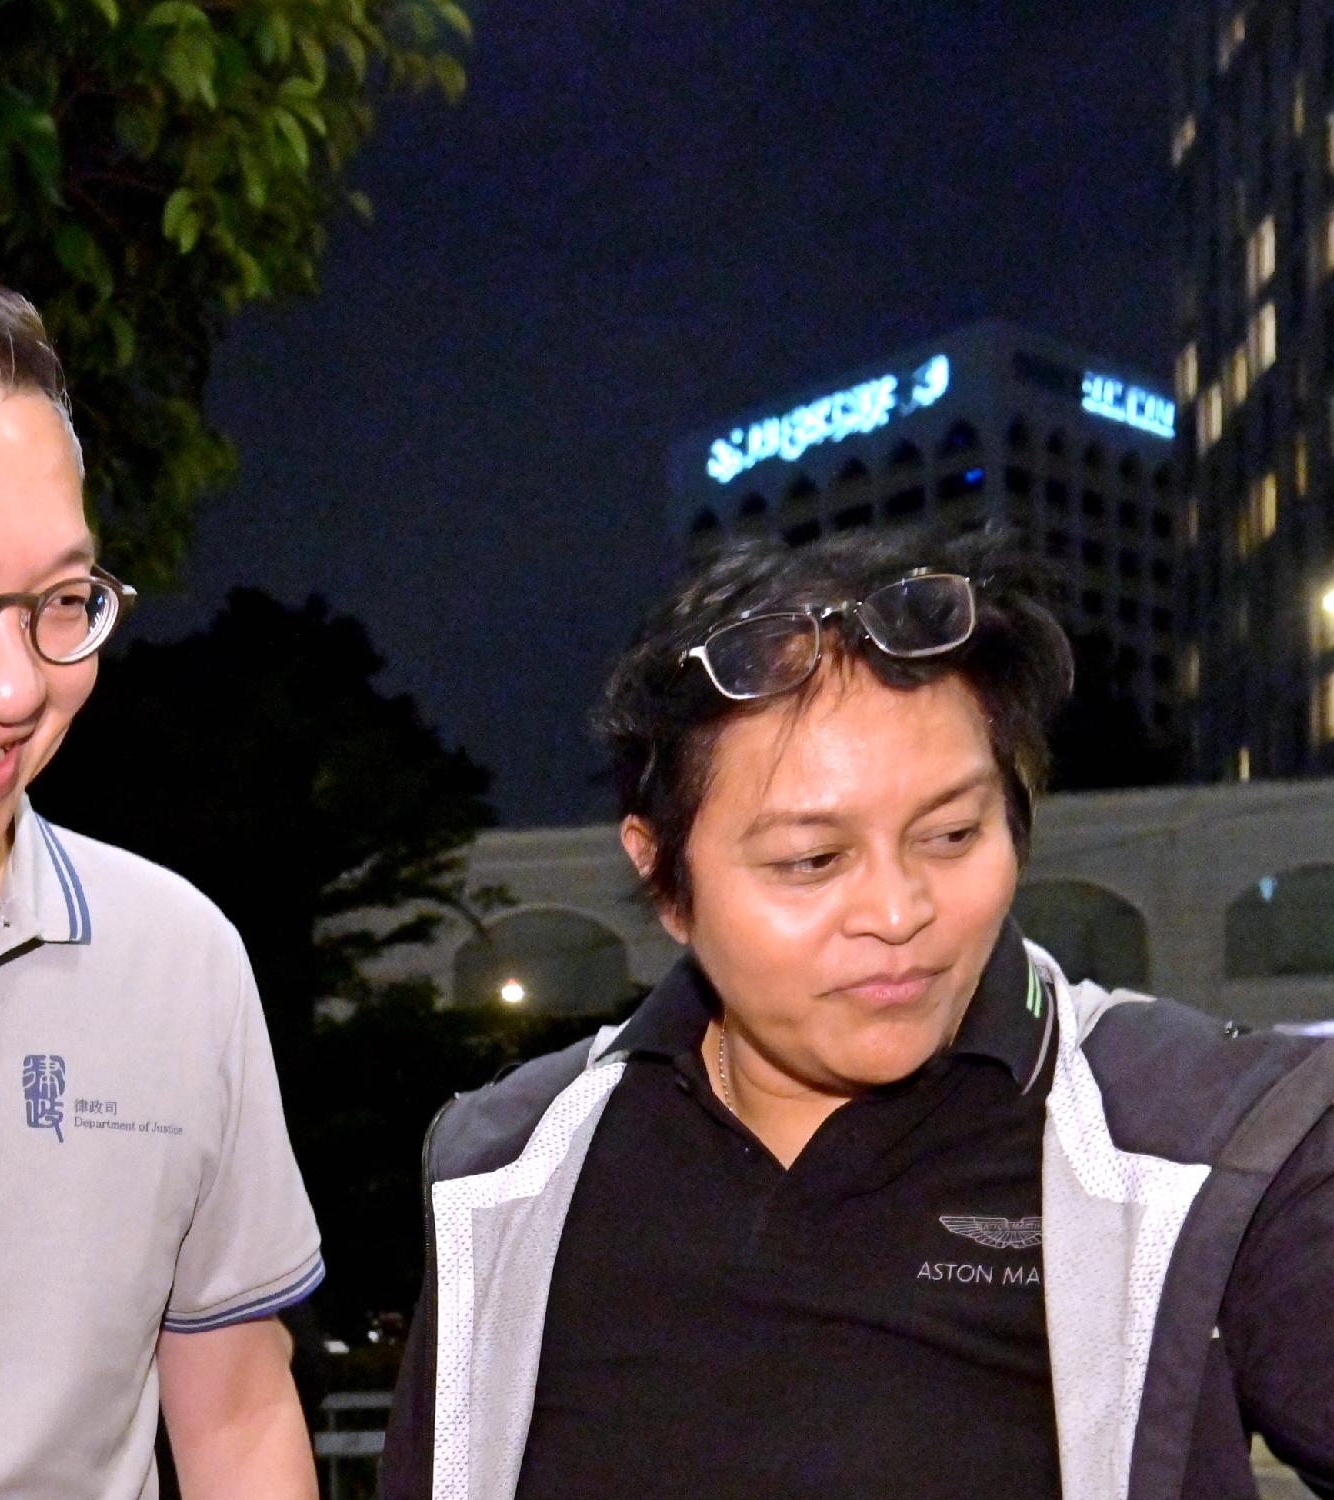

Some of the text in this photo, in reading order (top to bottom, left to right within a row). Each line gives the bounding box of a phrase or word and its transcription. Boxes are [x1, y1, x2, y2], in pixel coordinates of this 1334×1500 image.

[74, 1098, 117, 1115] 律政司
[74, 1116, 183, 1136] Department of Justice
[917, 1261, 993, 1285] ASTON
